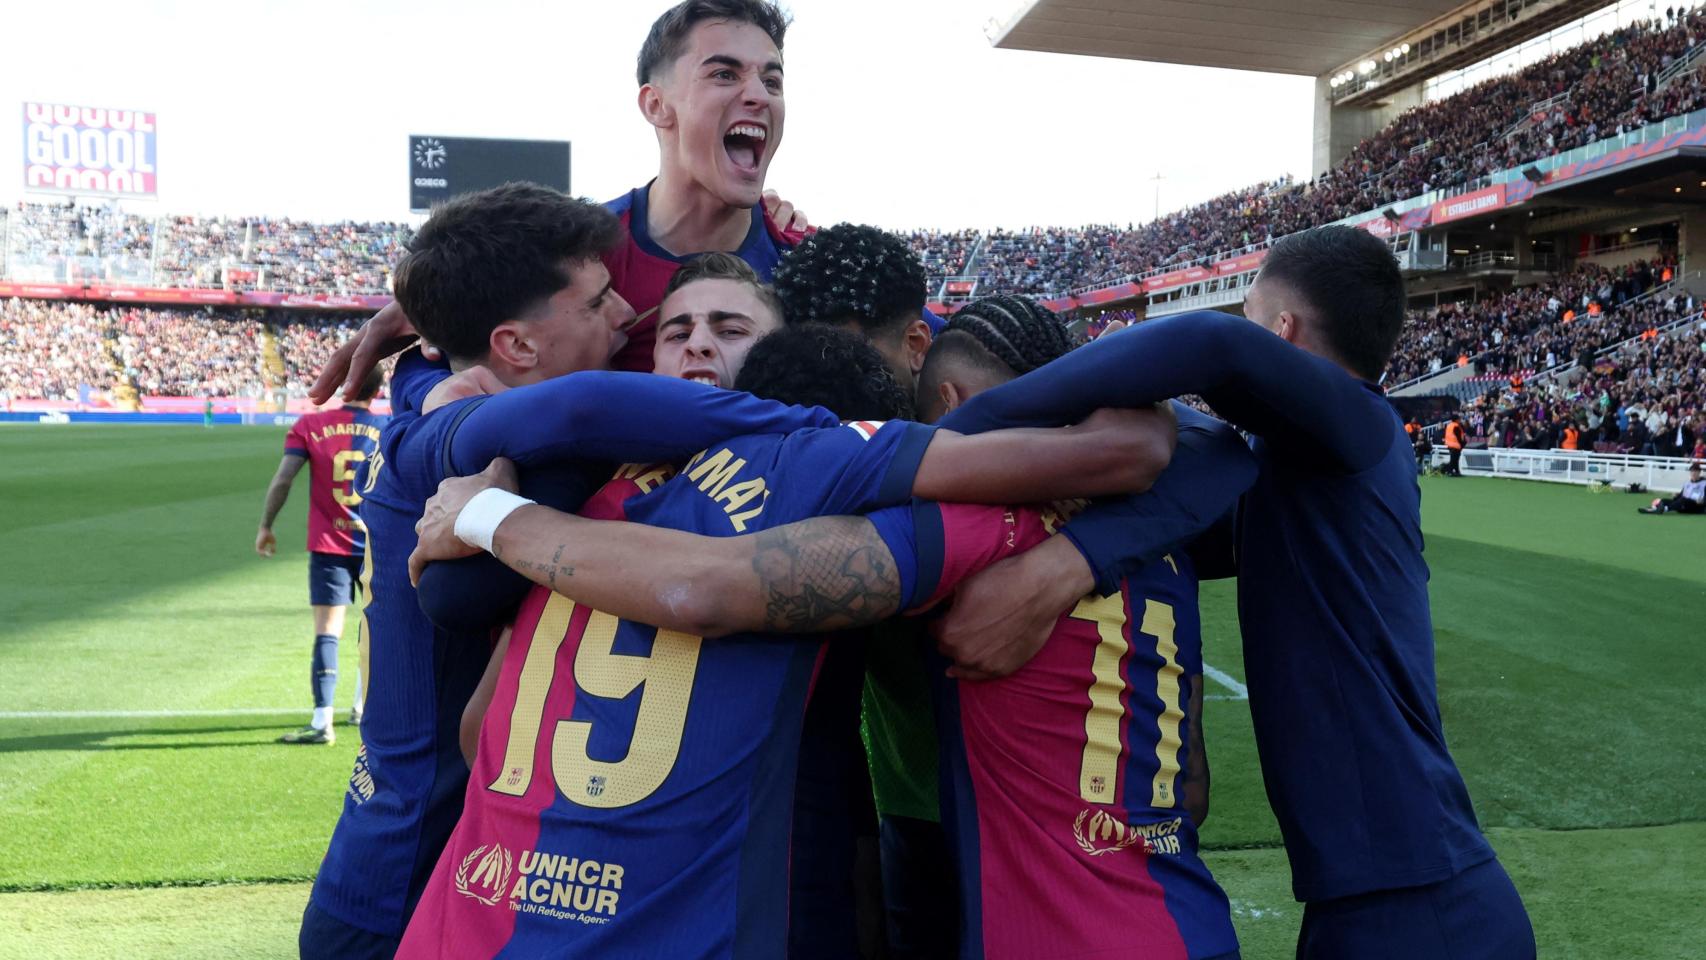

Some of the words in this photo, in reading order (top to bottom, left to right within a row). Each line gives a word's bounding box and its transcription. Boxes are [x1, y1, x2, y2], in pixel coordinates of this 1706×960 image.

[27, 121, 154, 172] GOOOL
[1448, 199, 1477, 216] ESTRELLA
[1476, 193, 1498, 208] DAMM
[332, 450, 366, 507] 5
[487, 590, 703, 809] 19
[1069, 590, 1186, 808] 11
[518, 850, 625, 889] UNHCR
[509, 875, 619, 916] ACNUR
[509, 901, 522, 911] The
[522, 903, 537, 914] UN
[537, 906, 577, 921] Refugee
[577, 912, 610, 925] Agenc
